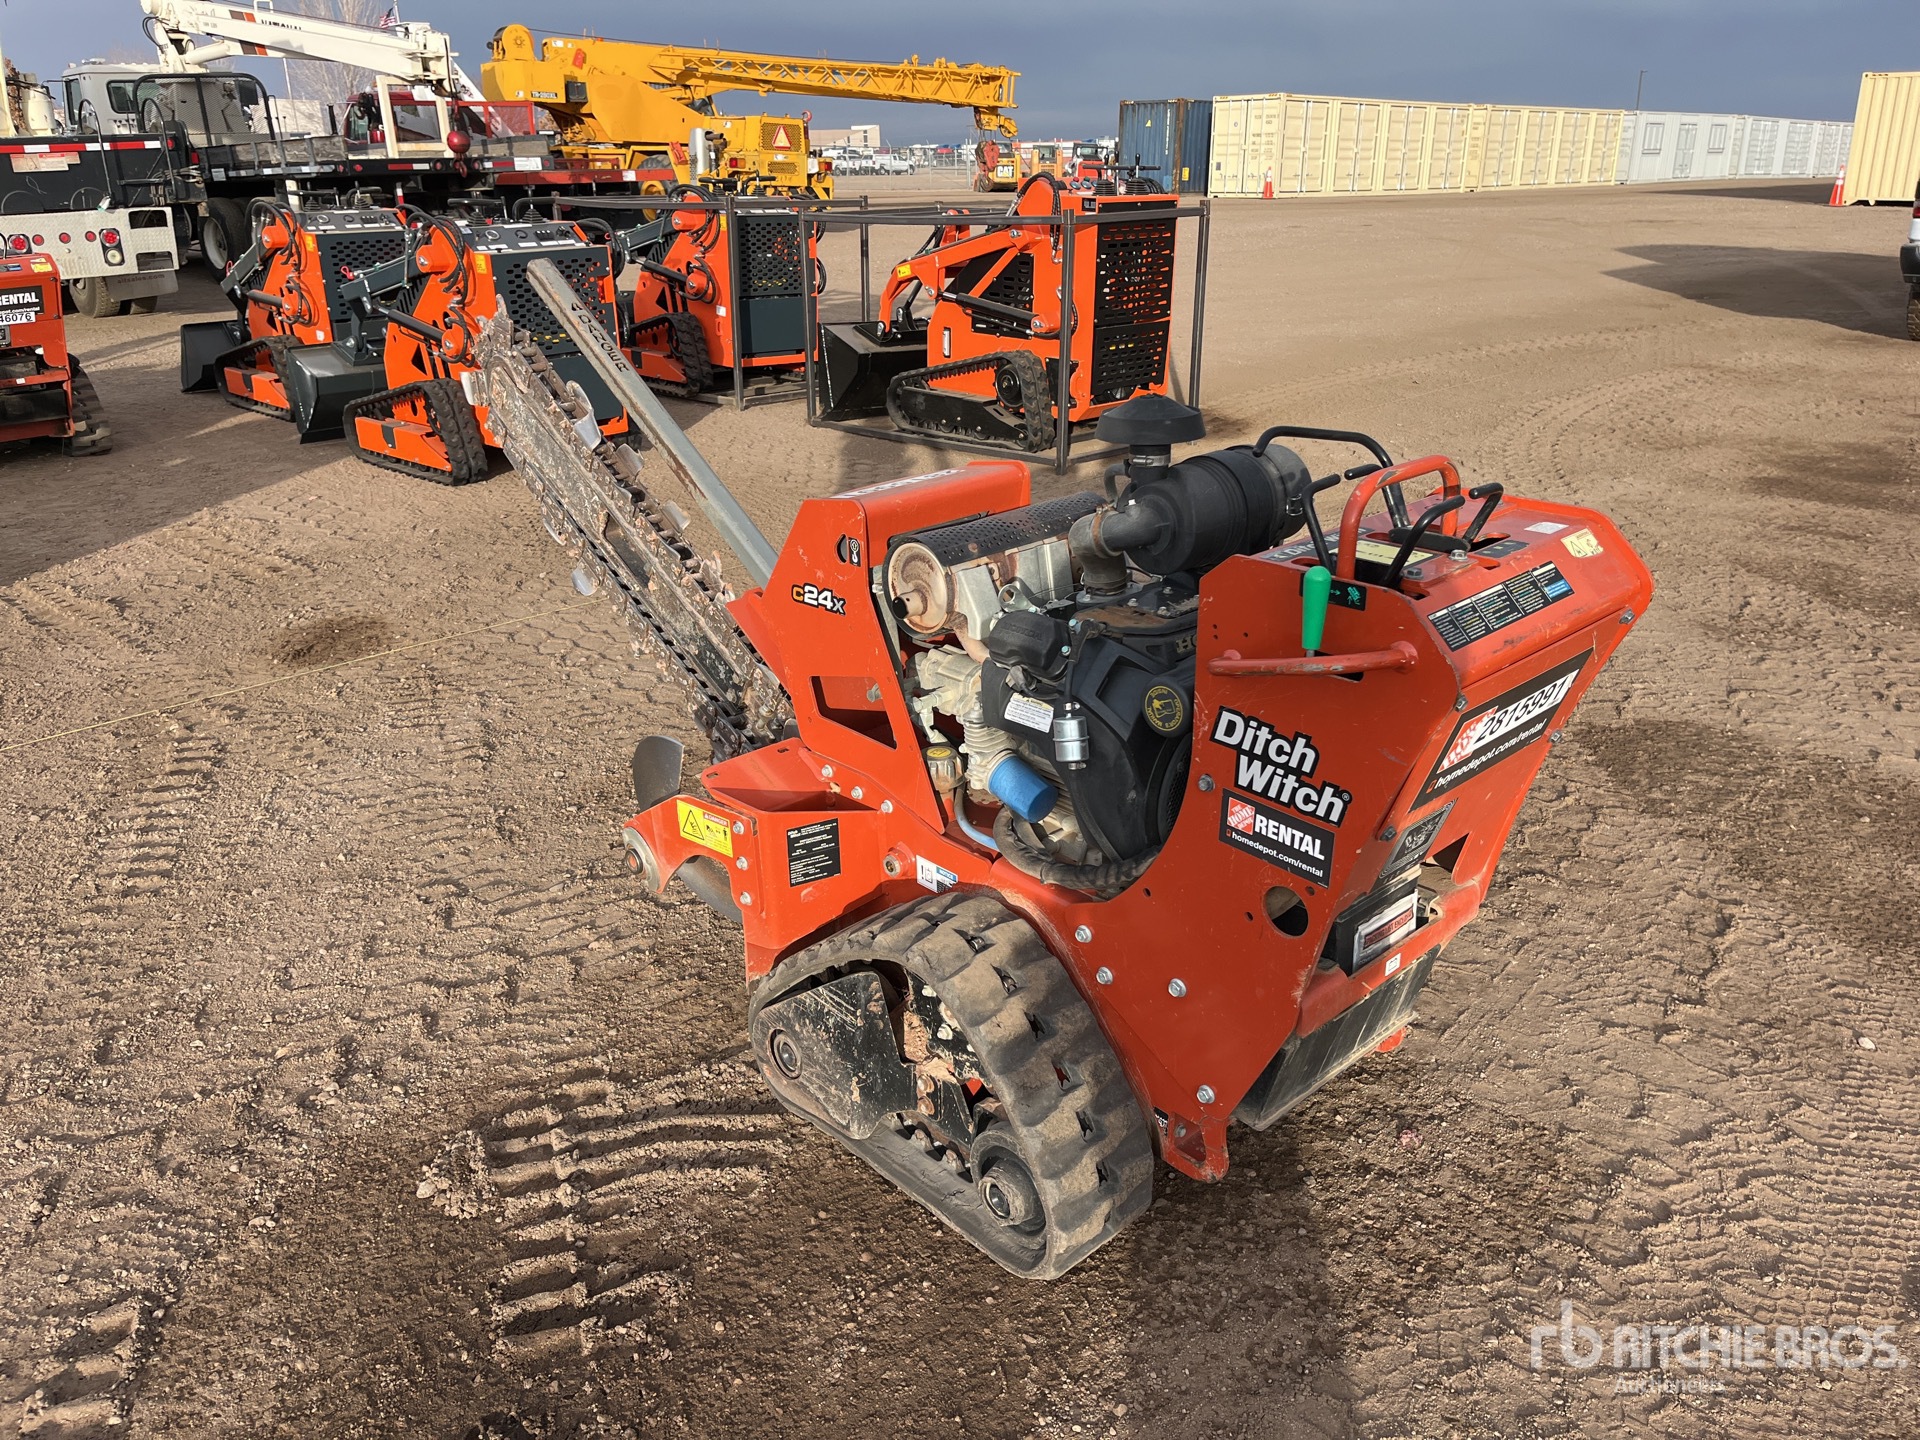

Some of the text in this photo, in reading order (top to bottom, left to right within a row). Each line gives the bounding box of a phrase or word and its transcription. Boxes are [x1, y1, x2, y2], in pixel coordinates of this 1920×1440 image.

[997, 166, 1014, 178] CAT
[578, 314, 630, 372] DANGER
[1473, 676, 1569, 744] 2815991
[1214, 710, 1316, 773] Ditch
[1228, 806, 1254, 827] HOME
[1255, 813, 1325, 861] RENTAL
[1232, 831, 1323, 878] homedepot.com/rental
